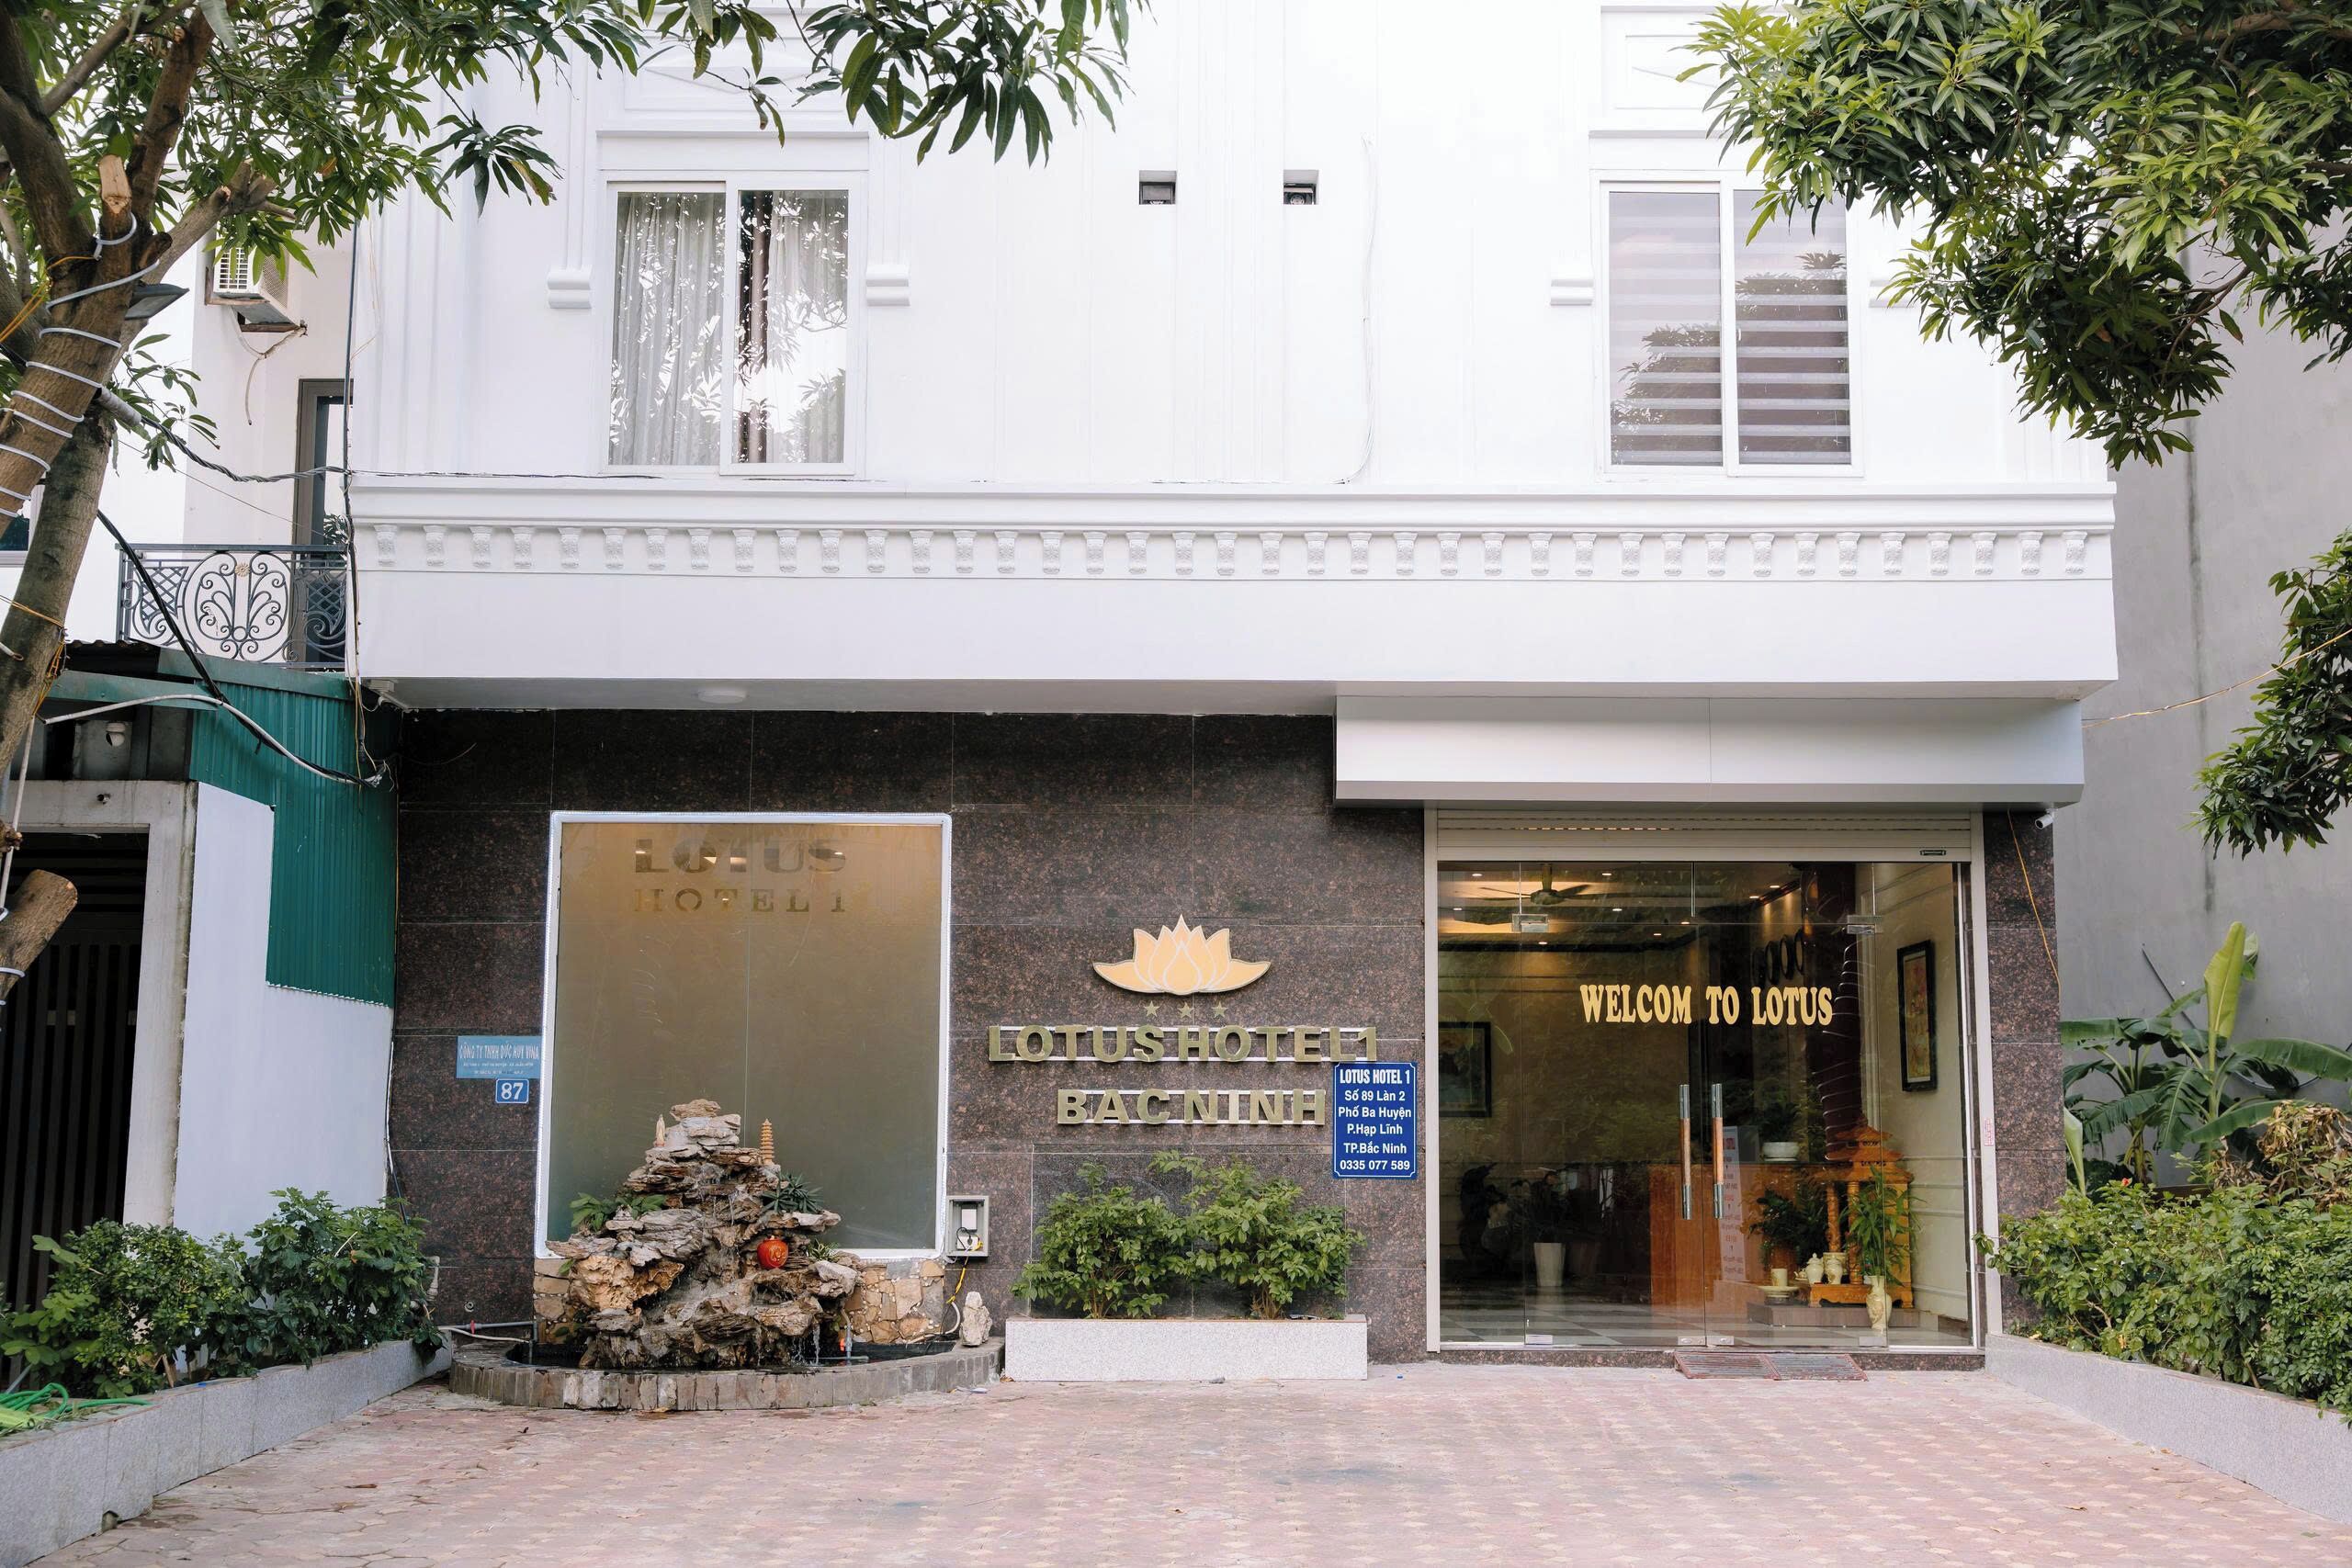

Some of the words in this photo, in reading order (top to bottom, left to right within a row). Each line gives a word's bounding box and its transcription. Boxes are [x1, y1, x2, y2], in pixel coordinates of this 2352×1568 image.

[634, 887, 809, 912] HOTEL
[831, 888, 845, 912] 1
[1580, 984, 1692, 1024] WELCOM
[1706, 986, 1740, 1025] TO
[1751, 987, 1833, 1026] LOTUS
[1340, 1068, 1370, 1084] LOTUS
[1373, 1068, 1403, 1084] HOTEL
[1405, 1069, 1410, 1084] 1
[501, 1082, 524, 1100] 87
[1344, 1089, 1360, 1101] Số
[1362, 1090, 1374, 1101] 89
[1377, 1089, 1396, 1101] Làn
[1398, 1090, 1406, 1101] 2
[1338, 1105, 1360, 1118] Phố
[1362, 1107, 1375, 1118] Ba
[1378, 1107, 1412, 1120] Huyện
[1347, 1123, 1377, 1136] P.Hạp
[1379, 1123, 1403, 1134] Lĩnh
[1343, 1141, 1380, 1154] TP.Bắc
[1382, 1143, 1408, 1154] Ninh
[1340, 1159, 1365, 1170] 0335
[1368, 1159, 1388, 1170] 077
[1390, 1159, 1410, 1170] 589
